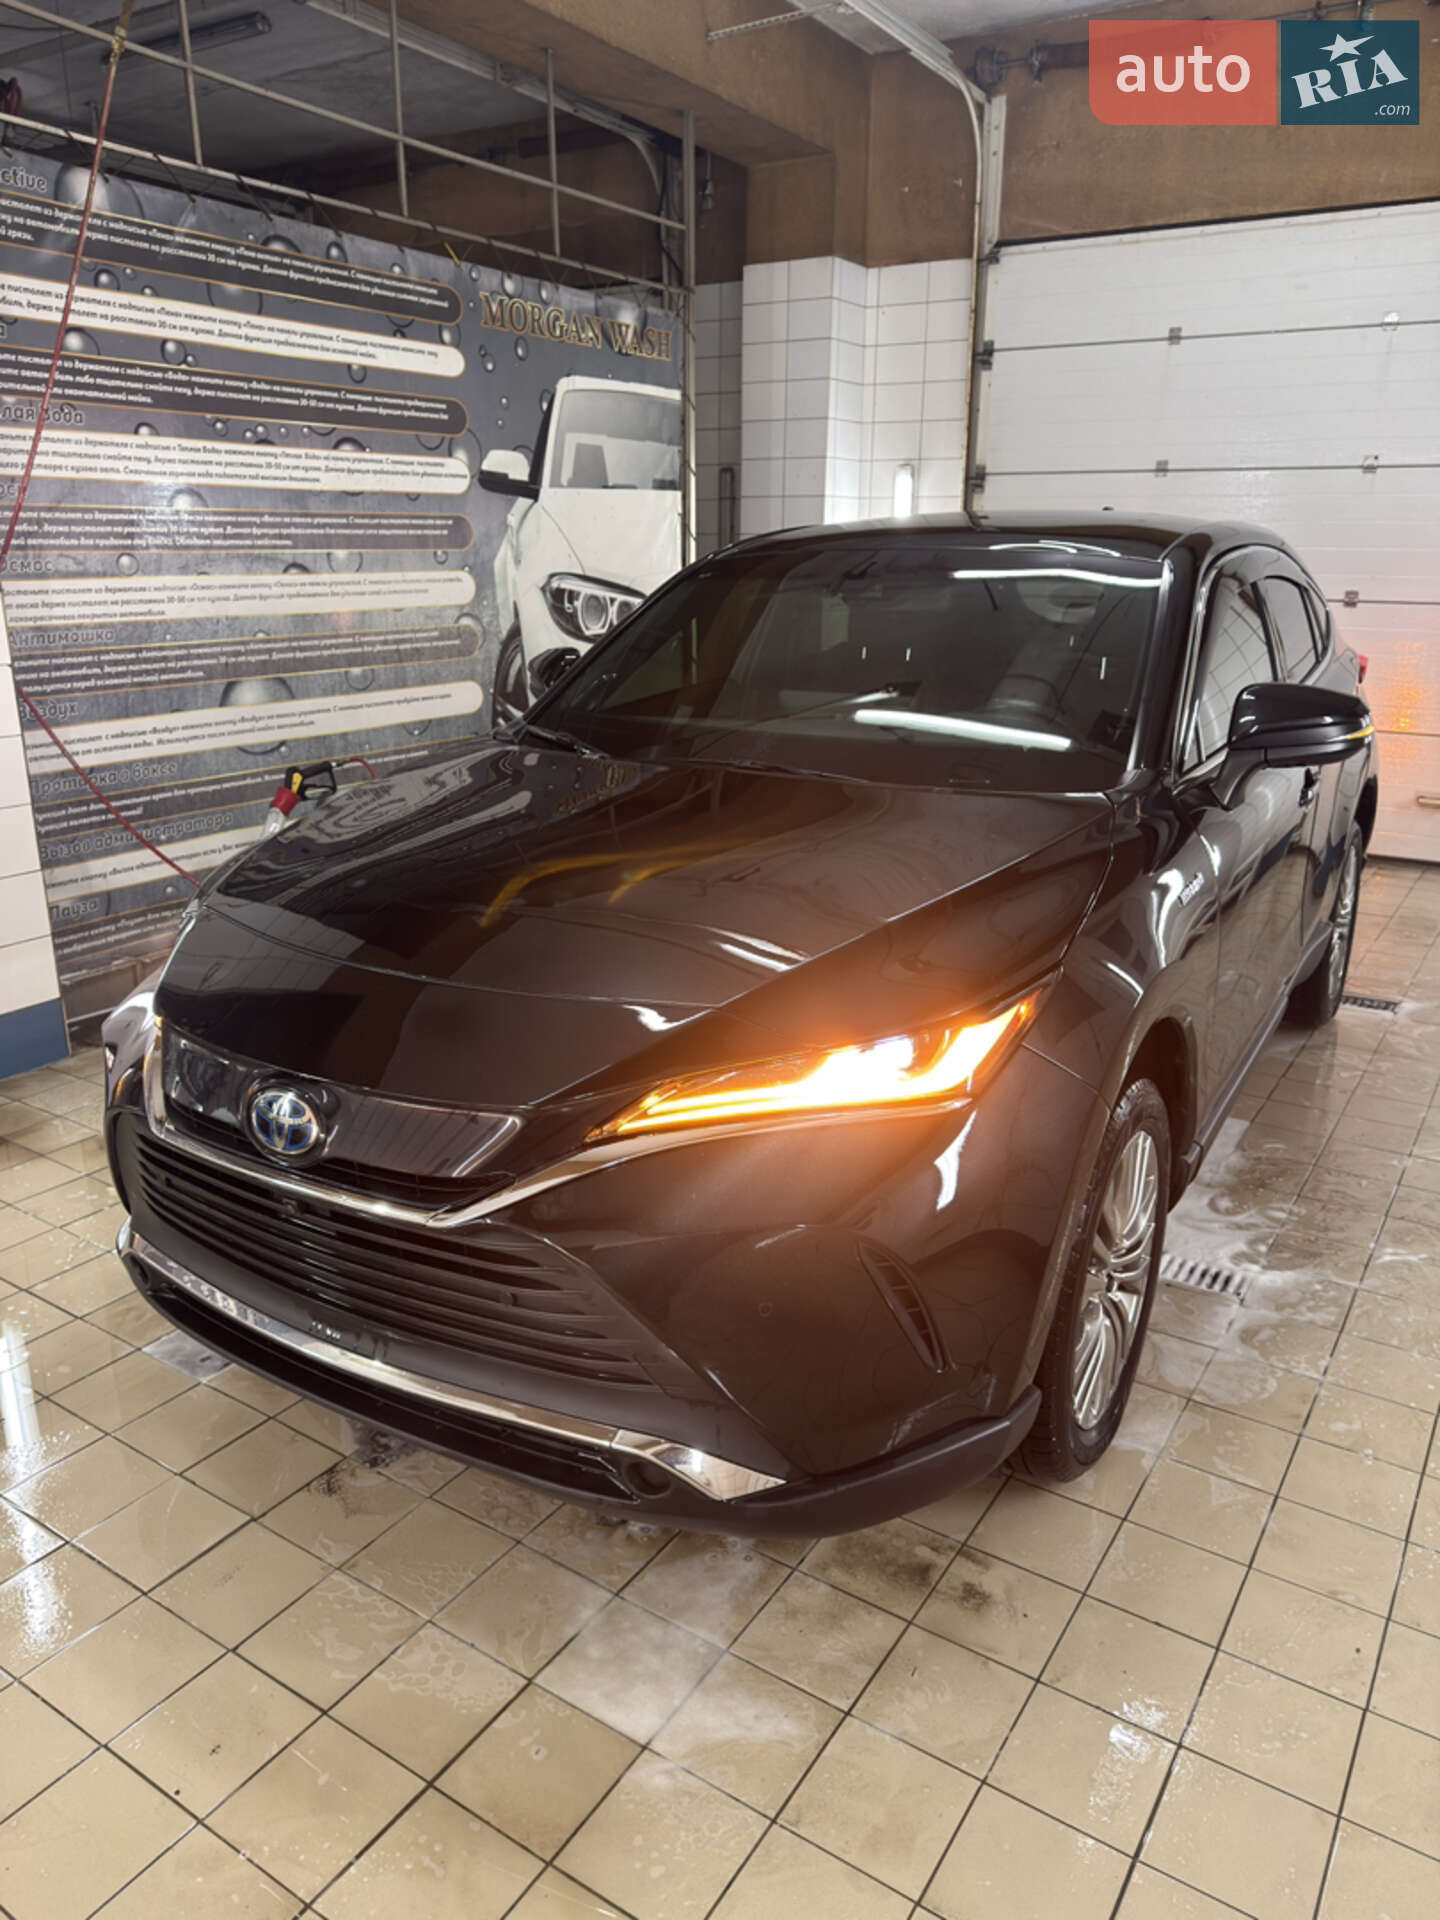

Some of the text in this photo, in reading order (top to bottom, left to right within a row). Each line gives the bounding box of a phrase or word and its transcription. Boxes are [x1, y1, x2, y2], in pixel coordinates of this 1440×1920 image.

[7, 284, 52, 298] пистолет
[55, 306, 97, 319] питолет
[480, 292, 604, 349] MORGAN
[608, 320, 672, 361] WASH
[17, 353, 61, 366] пистолт
[43, 405, 83, 423] ода
[31, 435, 72, 445] пстолет
[0, 559, 53, 572] смос
[5, 587, 48, 595] останьте
[9, 631, 113, 646] Антимошка
[133, 761, 177, 782] боксе
[40, 840, 91, 861] Вызов
[95, 812, 233, 850] адмиистратора
[50, 899, 97, 919] Пауза
